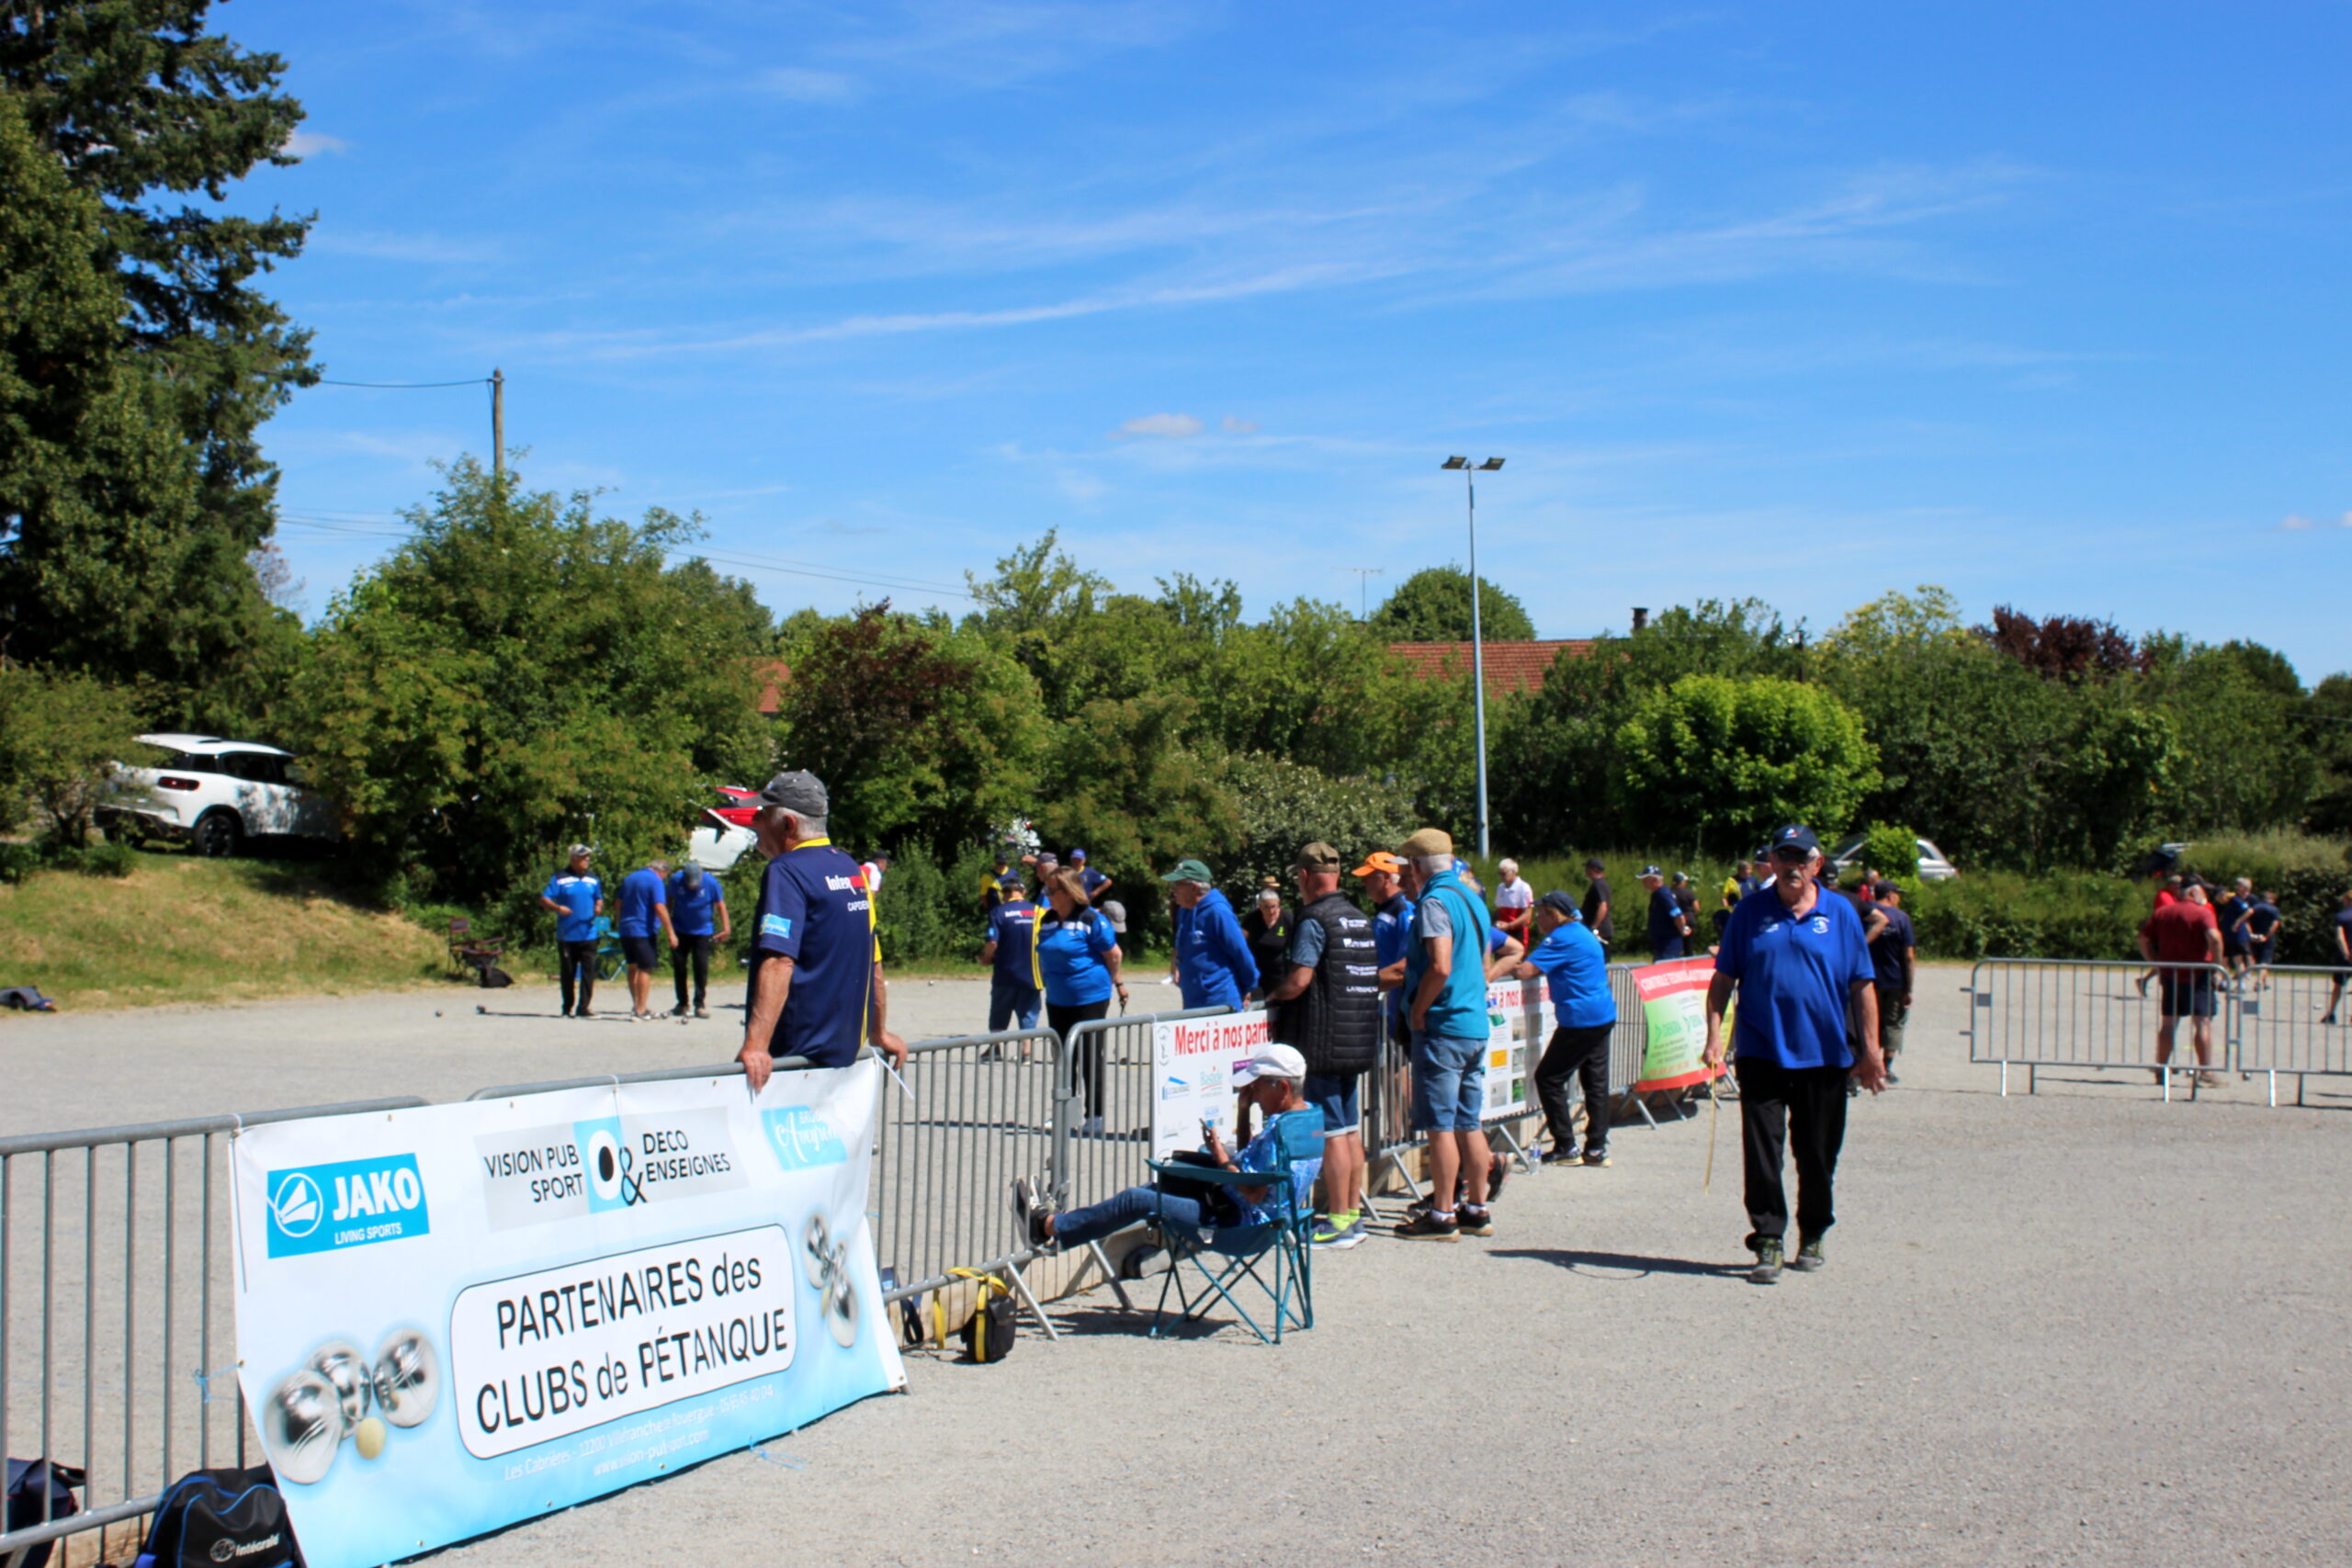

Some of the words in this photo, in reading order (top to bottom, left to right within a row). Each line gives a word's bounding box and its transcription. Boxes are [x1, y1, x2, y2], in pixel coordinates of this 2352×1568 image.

[1175, 1021, 1210, 1055] Merci
[1213, 1021, 1220, 1050] à
[1223, 1025, 1243, 1049] nos
[642, 1130, 689, 1156] DECO
[484, 1150, 543, 1179] VISION
[548, 1145, 580, 1169] PUB
[646, 1153, 732, 1183] ENSEIGNES
[332, 1168, 421, 1222] JAKO
[531, 1173, 584, 1203] SPORT
[334, 1228, 365, 1245] LIVING
[367, 1222, 402, 1240] SPORTS
[497, 1258, 703, 1350] PARTENAIRES
[712, 1251, 763, 1298] des
[476, 1360, 588, 1435] CLUBS
[597, 1352, 628, 1401] de
[639, 1308, 788, 1389] PÉTANQUE
